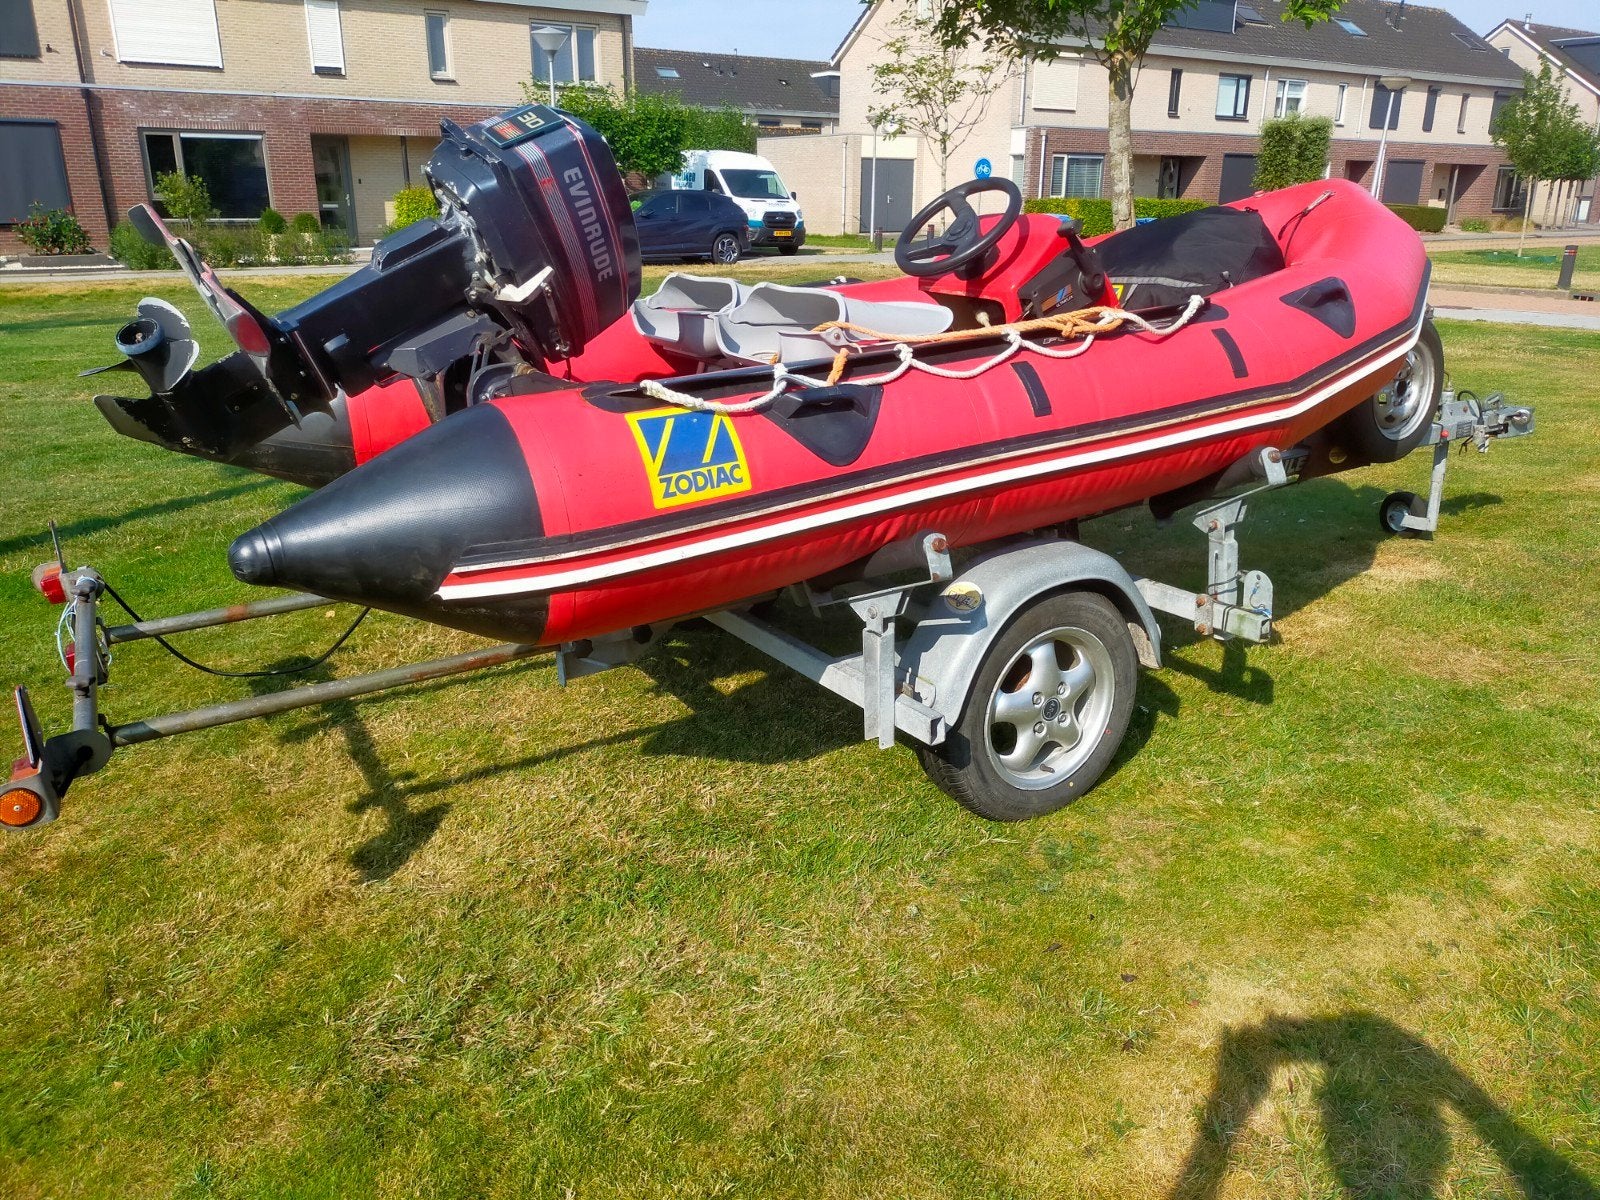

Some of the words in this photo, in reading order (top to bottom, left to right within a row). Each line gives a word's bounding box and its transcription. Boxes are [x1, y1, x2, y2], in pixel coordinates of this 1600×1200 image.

[517, 111, 545, 129] 30
[563, 166, 613, 283] EVINRUDE
[659, 463, 744, 499] ZODIAC
